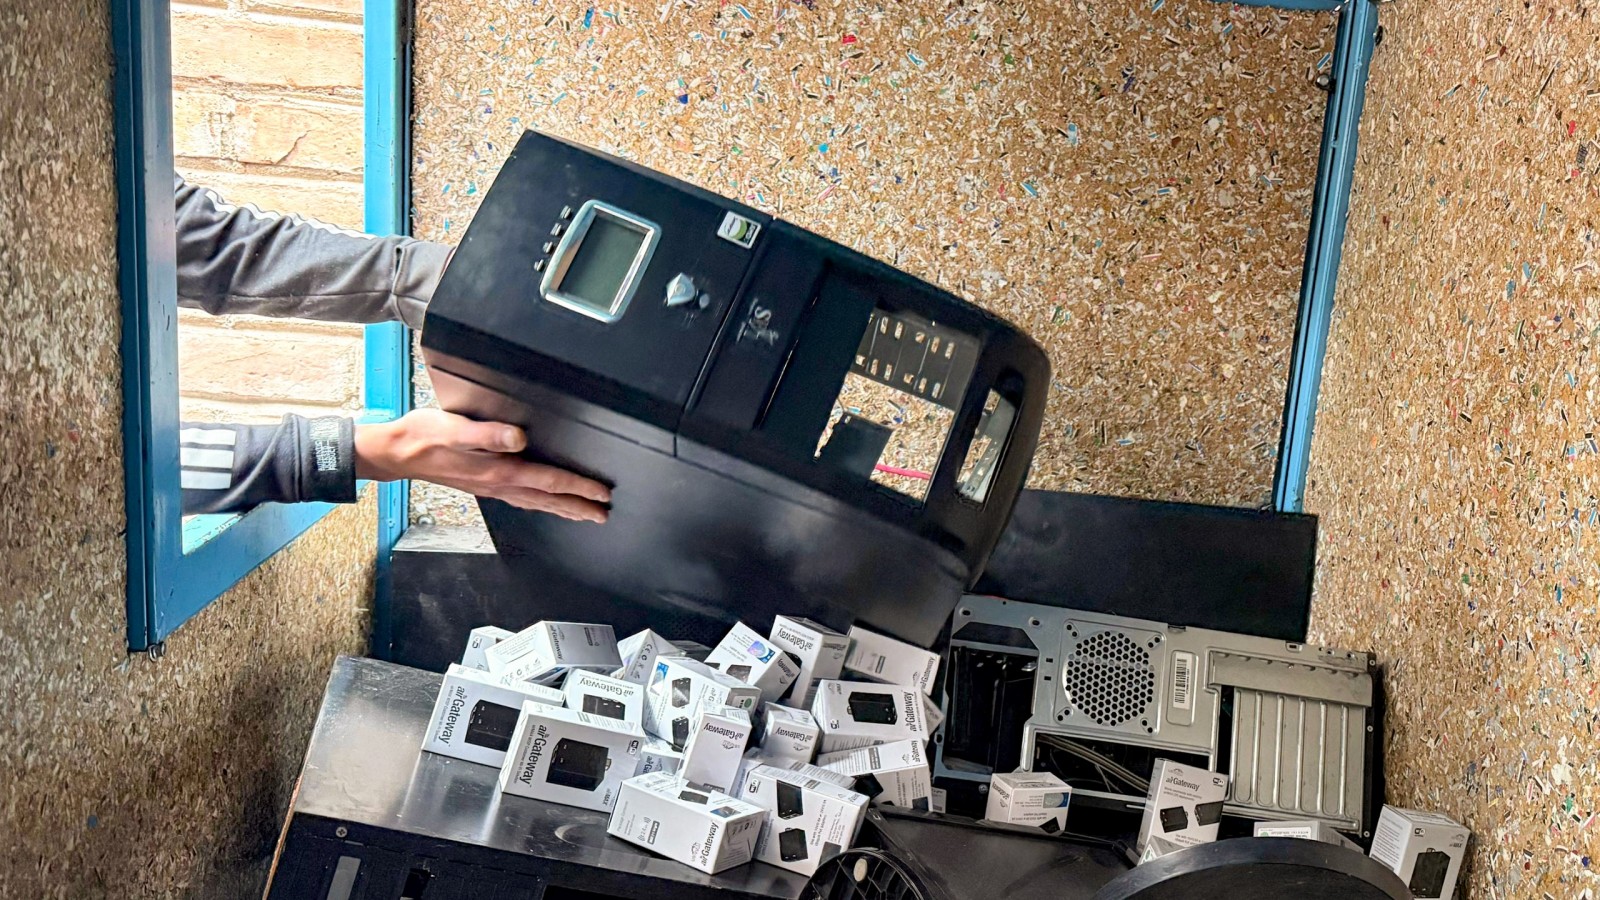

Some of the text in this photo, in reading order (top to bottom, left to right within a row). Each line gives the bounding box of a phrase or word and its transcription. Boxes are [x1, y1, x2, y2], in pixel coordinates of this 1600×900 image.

[778, 628, 813, 651] airGateway
[920, 656, 936, 689] airGateway
[579, 677, 634, 697] airGateway
[438, 686, 468, 745] airGateway
[904, 692, 917, 731] airGateway
[703, 722, 744, 740] airGateway
[776, 726, 814, 742] airGateway
[519, 724, 549, 785] airGateway
[643, 755, 654, 773] airGa
[1165, 776, 1200, 792] airGateway
[699, 821, 719, 866] airGateway
